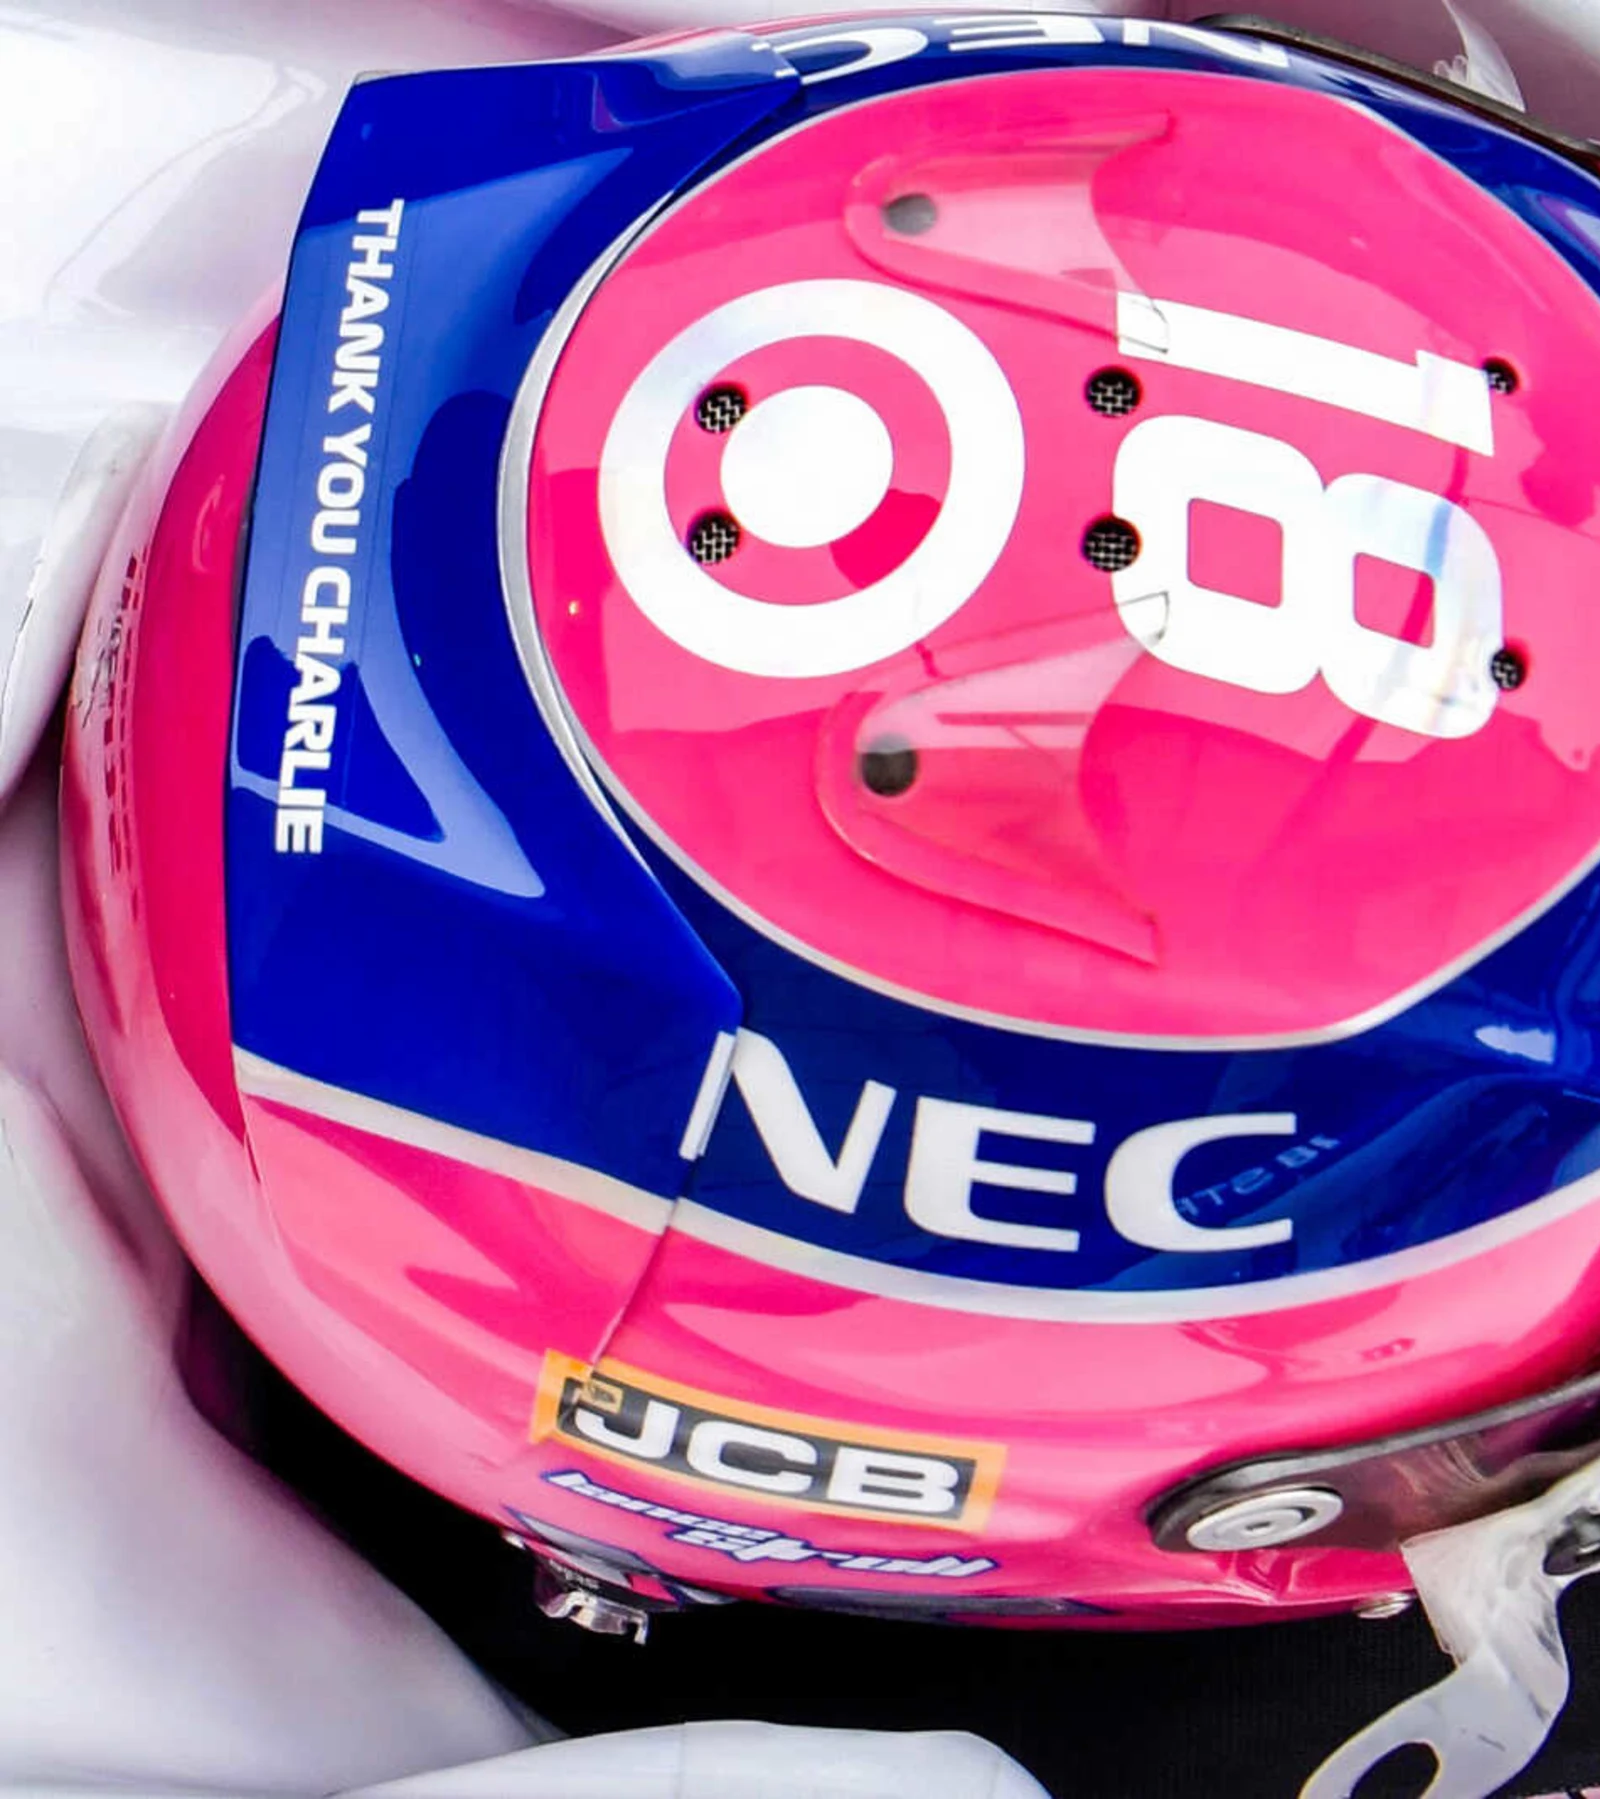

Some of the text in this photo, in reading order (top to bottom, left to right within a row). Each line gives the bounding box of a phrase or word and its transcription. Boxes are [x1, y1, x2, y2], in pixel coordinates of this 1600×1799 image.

[752, 14, 1290, 86] NEC
[274, 198, 404, 855] THANK YOU CHARLIE
[1110, 290, 1503, 741] 18
[678, 1026, 1298, 1253] NEC
[571, 1403, 960, 1515] JCB
